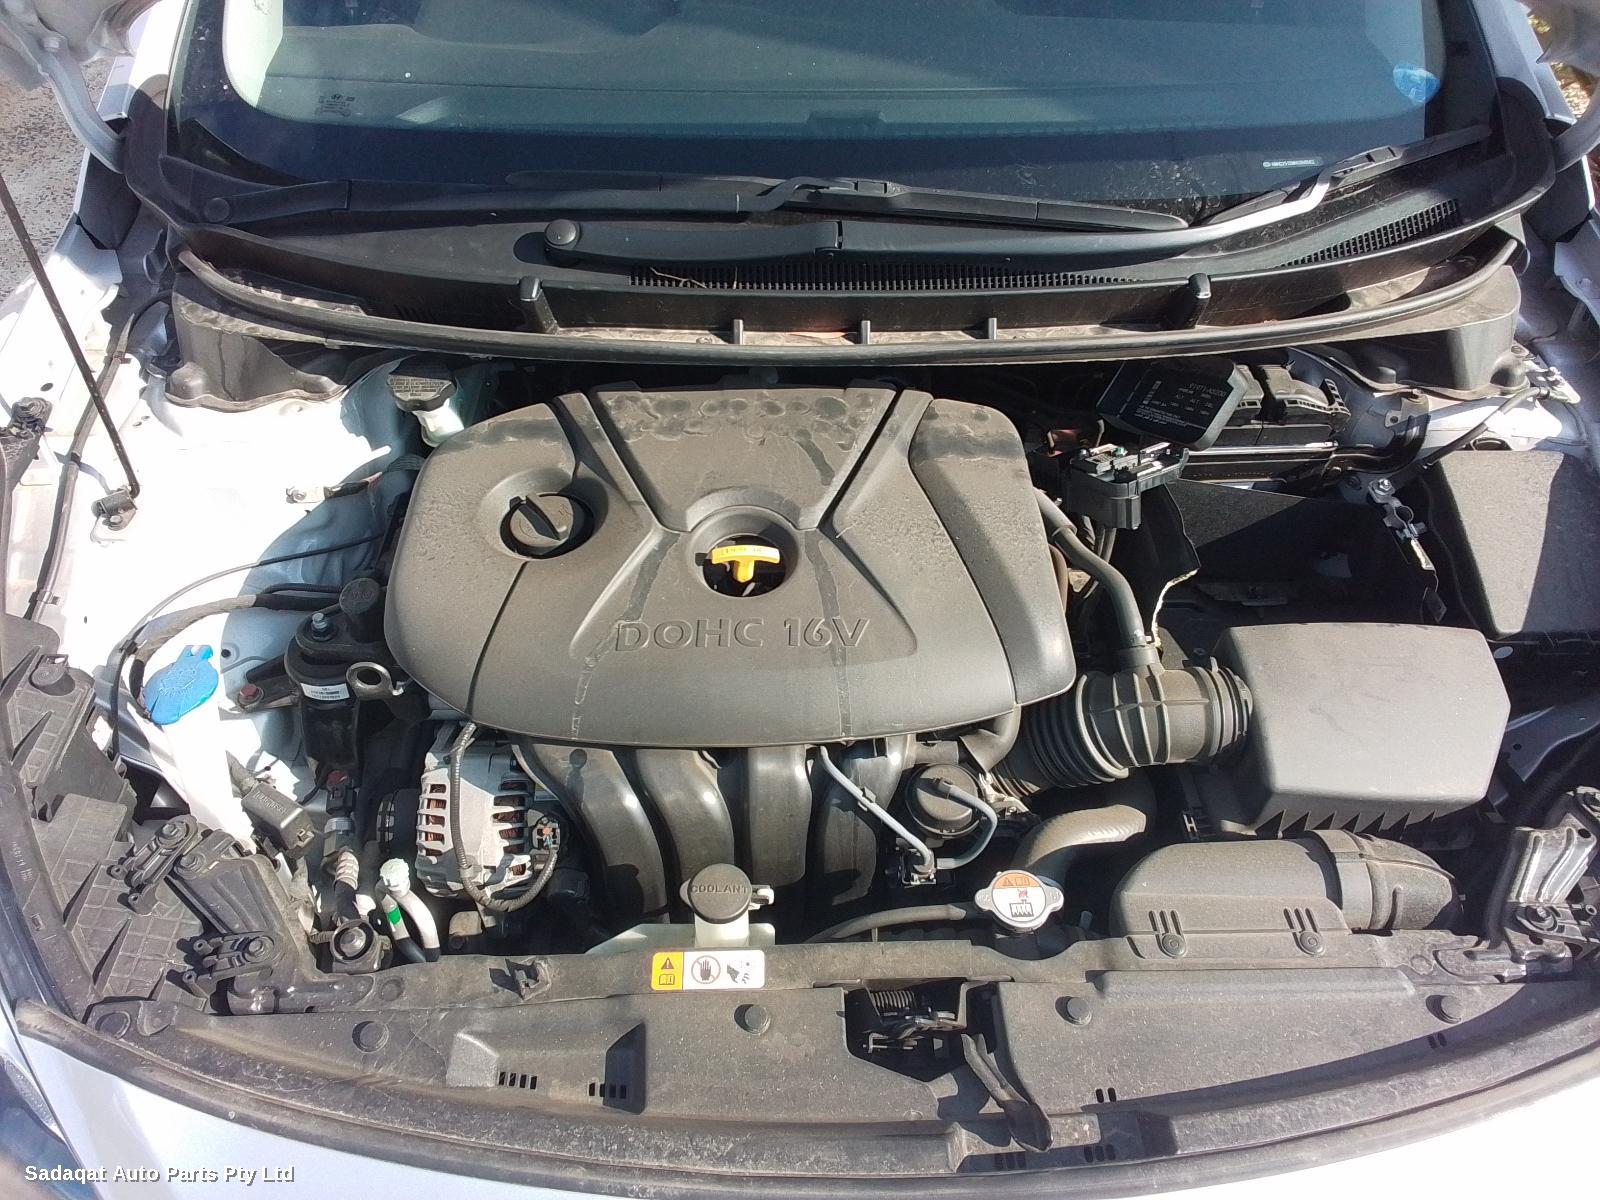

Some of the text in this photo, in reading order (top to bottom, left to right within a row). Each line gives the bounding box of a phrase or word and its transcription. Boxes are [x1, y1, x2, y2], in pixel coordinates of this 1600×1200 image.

[614, 616, 871, 652] DOHC 16V
[690, 883, 748, 894] COOLANT
